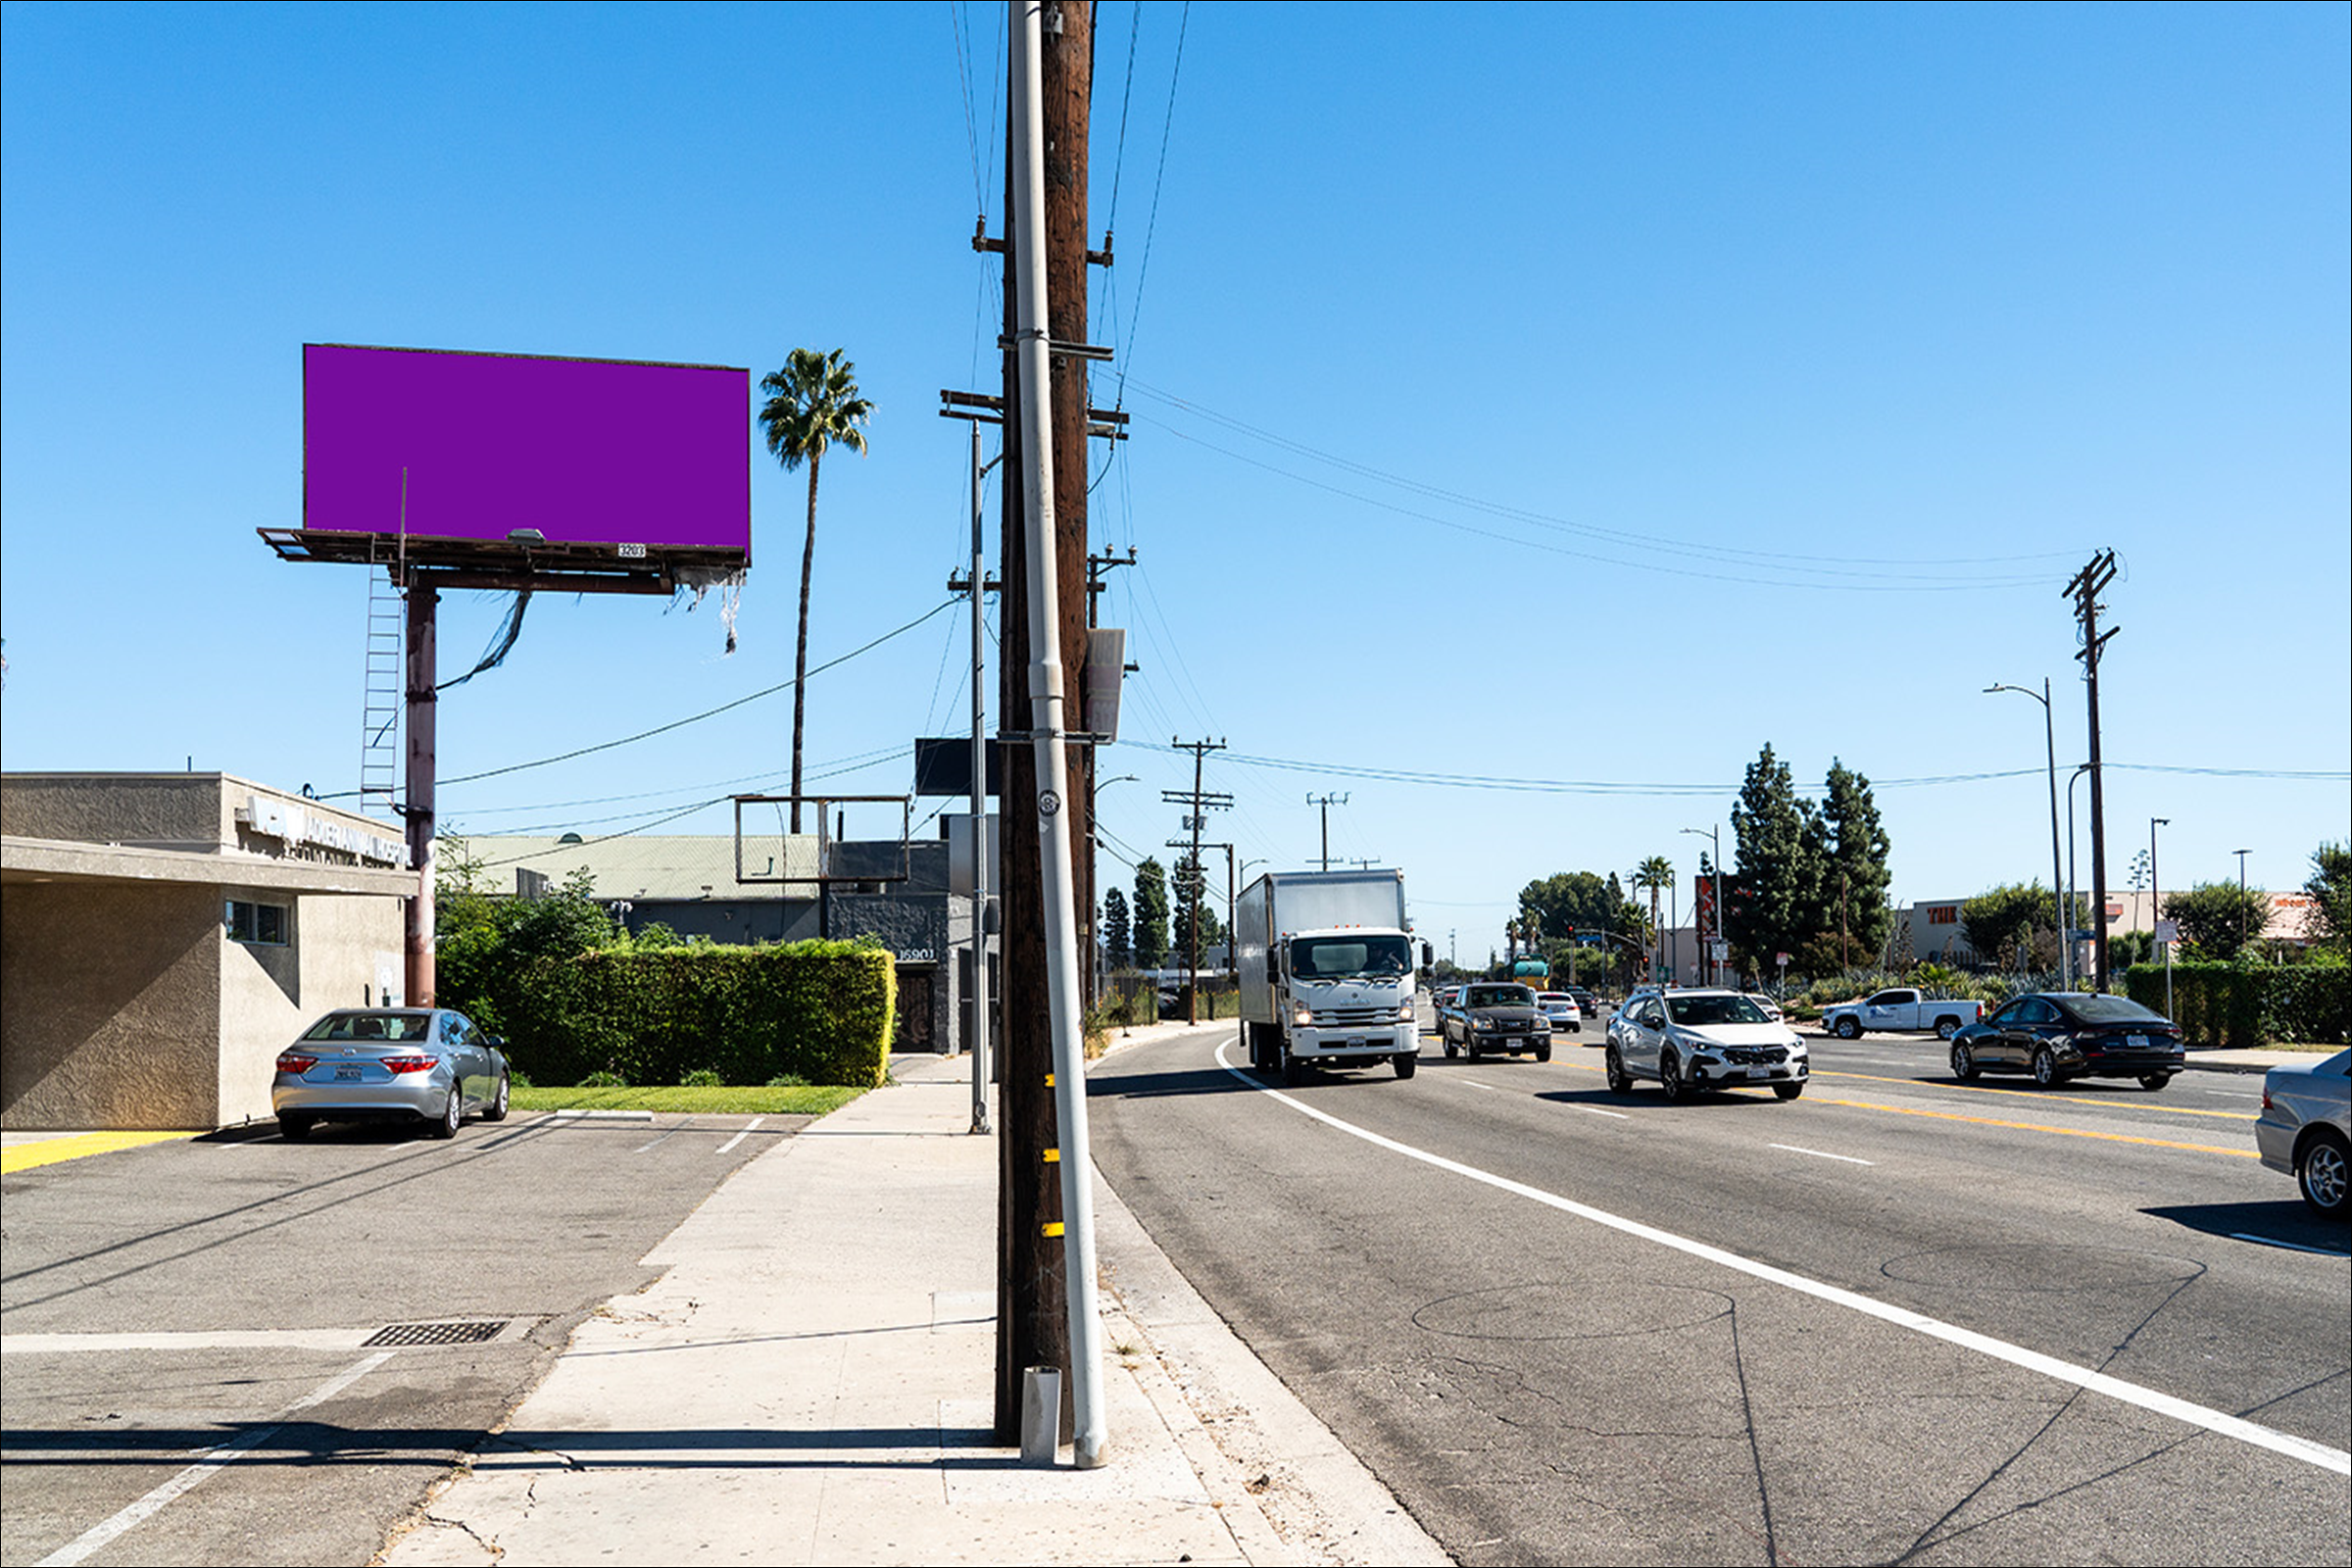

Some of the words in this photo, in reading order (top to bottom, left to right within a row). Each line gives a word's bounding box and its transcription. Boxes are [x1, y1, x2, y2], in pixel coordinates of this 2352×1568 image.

[619, 544, 644, 556] 3203
[1927, 906, 1956, 924] THE
[900, 948, 934, 960] 16901
